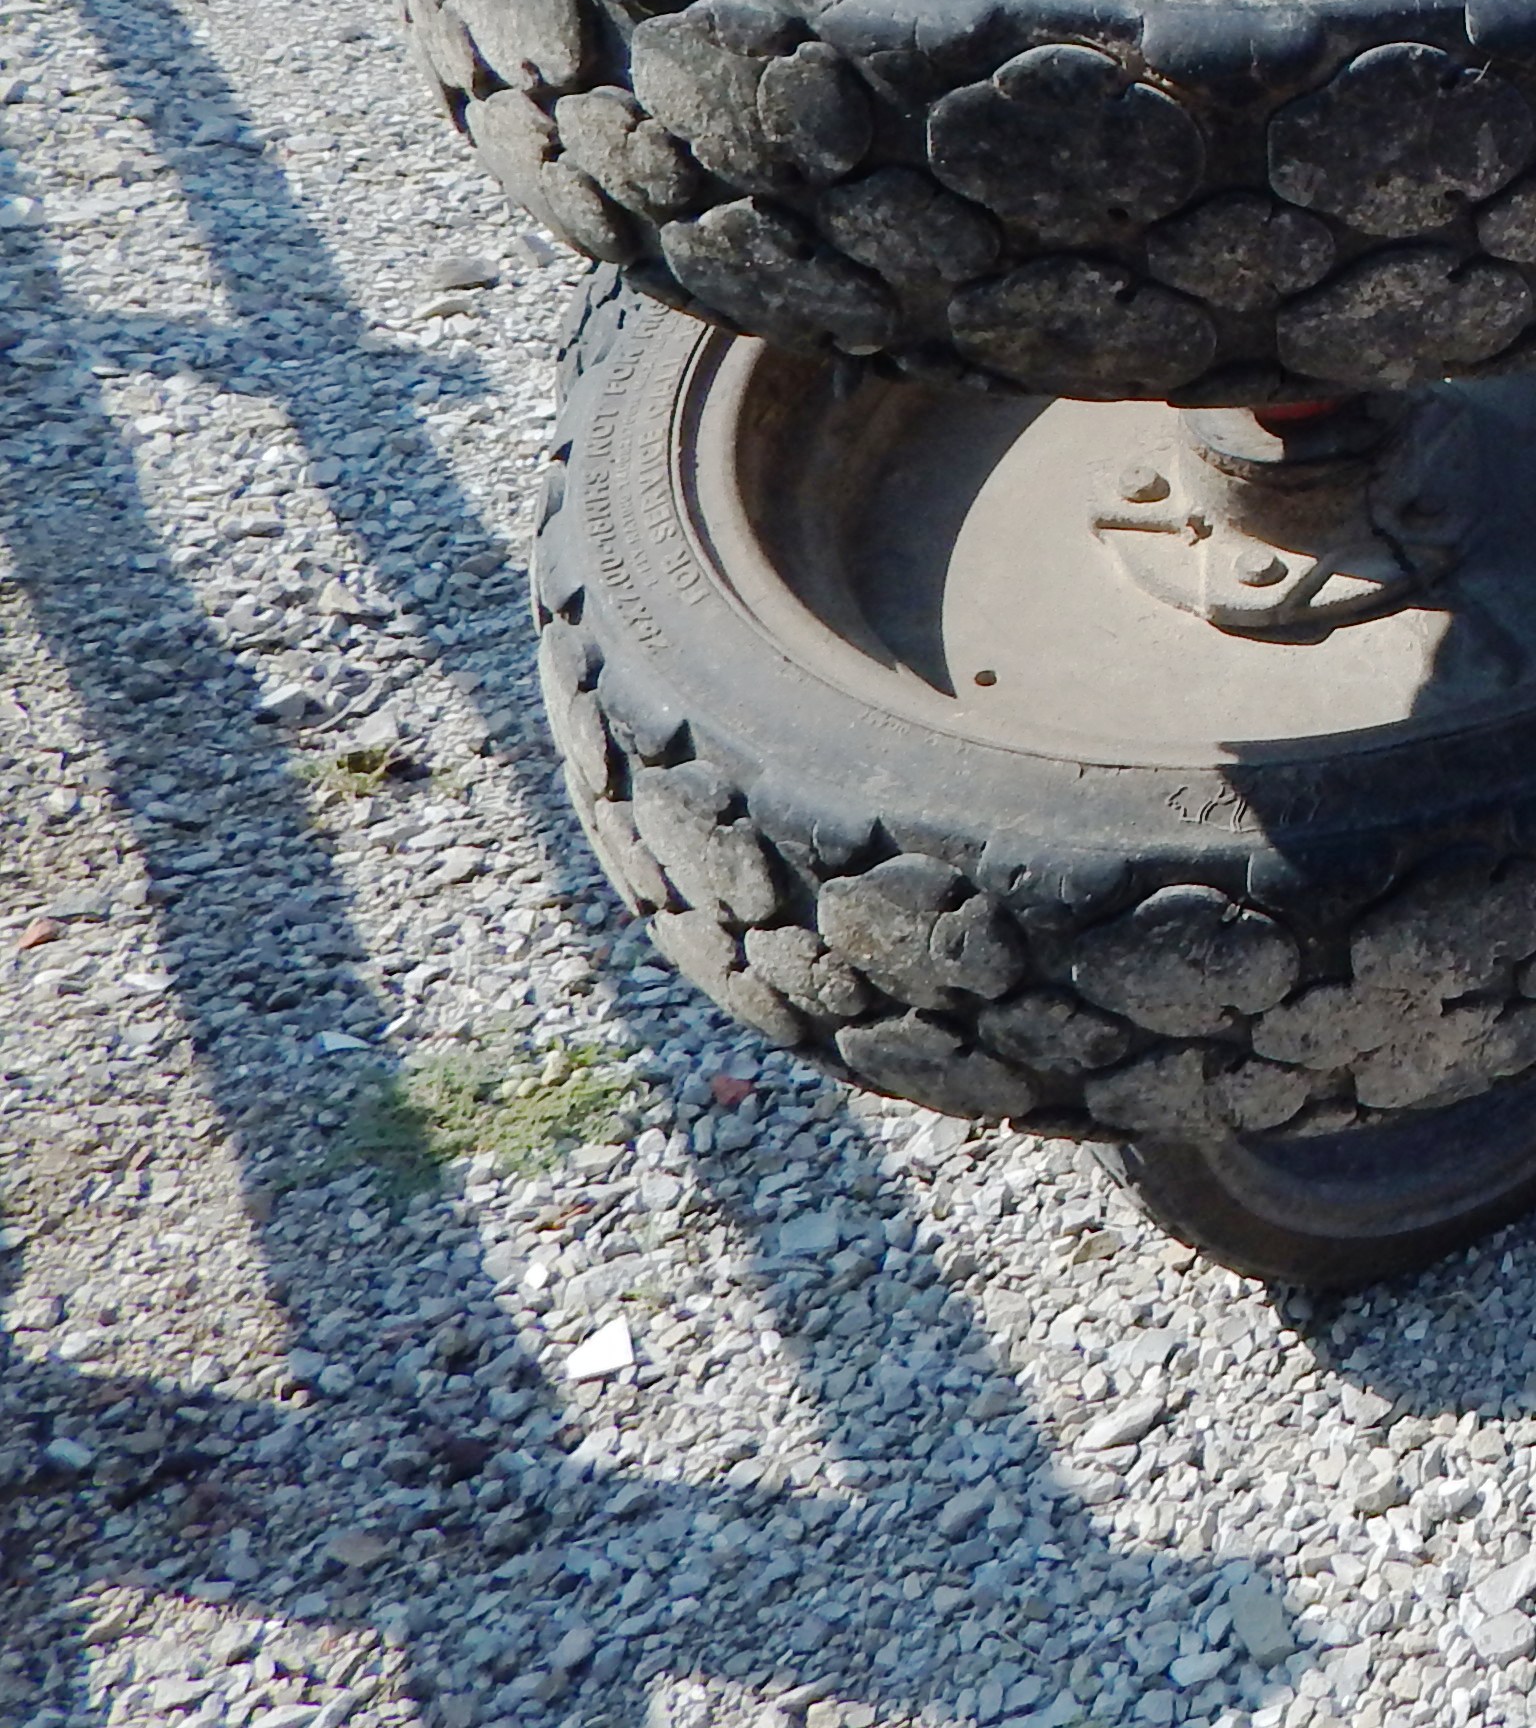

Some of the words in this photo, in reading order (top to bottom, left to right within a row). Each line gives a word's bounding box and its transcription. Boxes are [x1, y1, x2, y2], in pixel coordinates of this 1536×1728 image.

[586, 407, 619, 466] NOT
[637, 427, 678, 545] SERVICE
[659, 550, 711, 607] FOR
